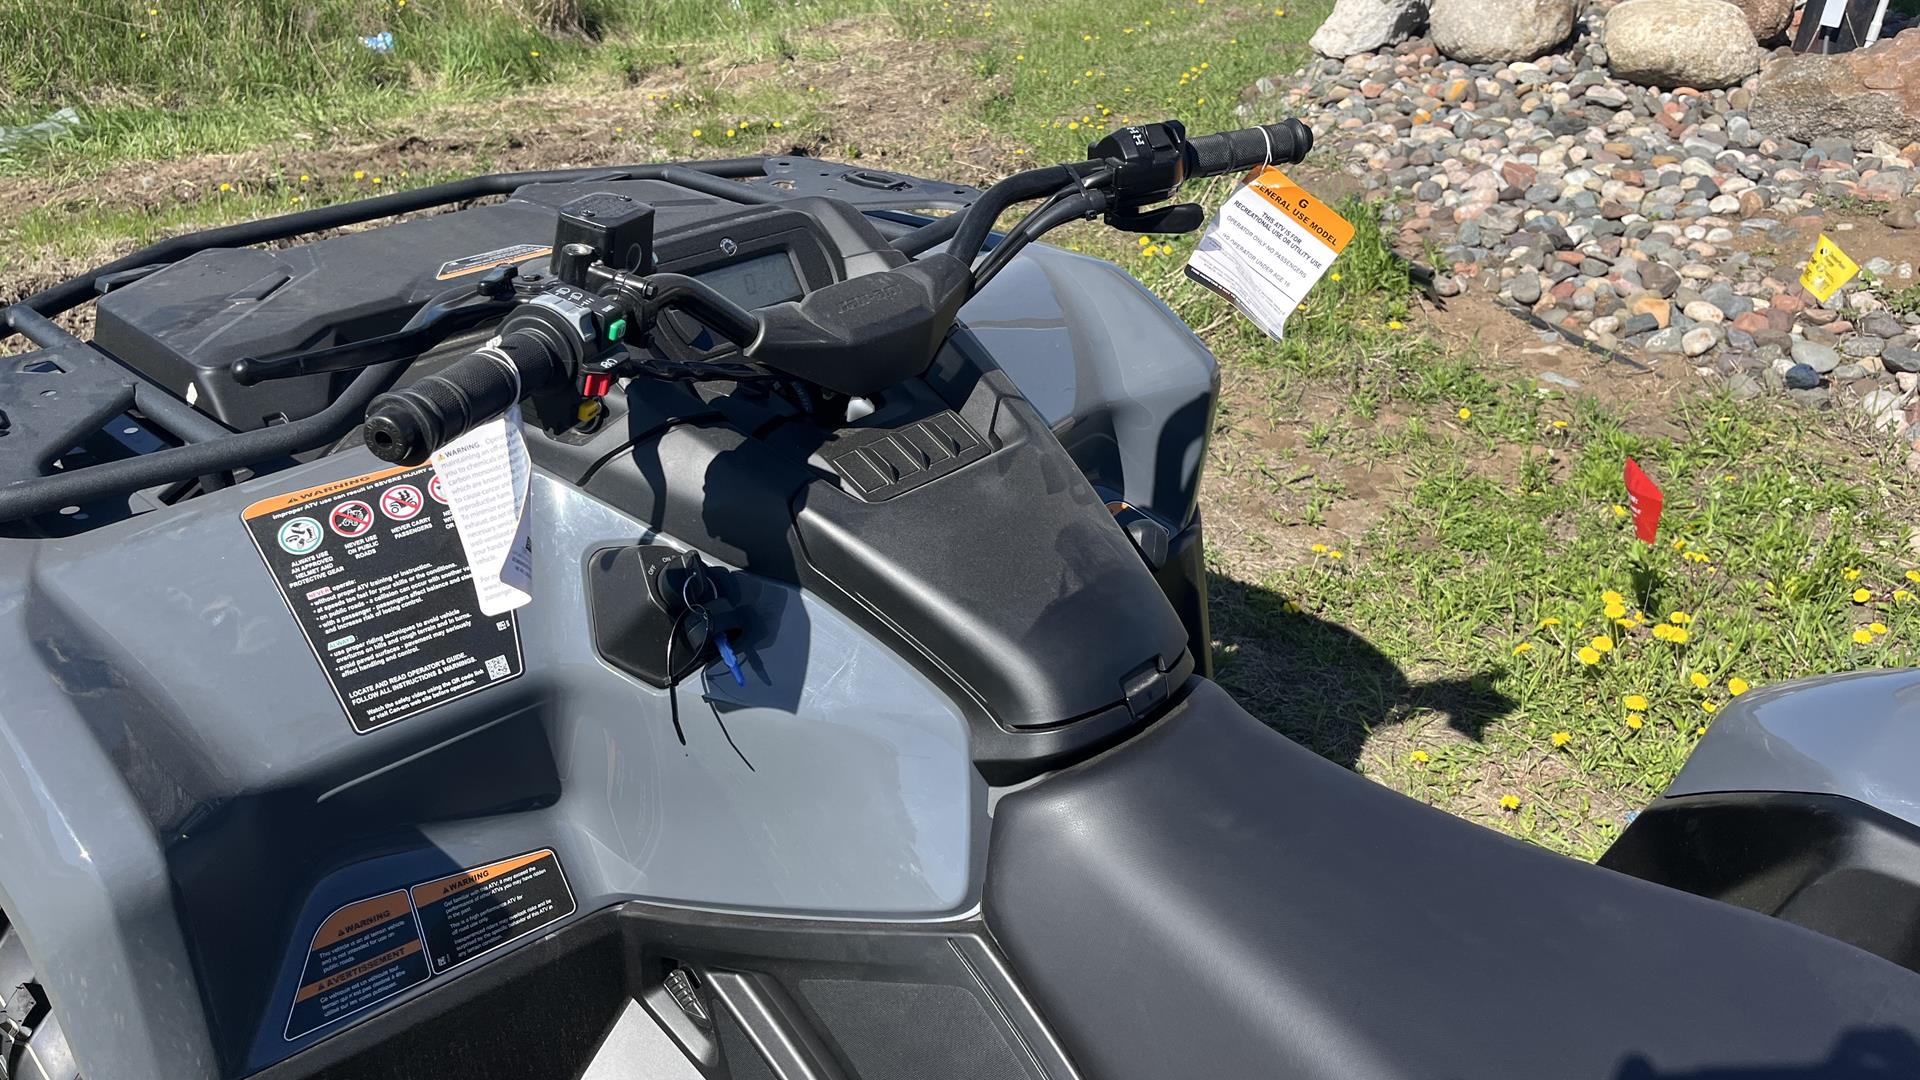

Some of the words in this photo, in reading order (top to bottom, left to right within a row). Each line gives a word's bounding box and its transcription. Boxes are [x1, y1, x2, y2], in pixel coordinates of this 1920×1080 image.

[1299, 199, 1309, 208] G
[1234, 200, 1272, 231] RECREATIONAL
[1272, 229, 1281, 239] USE
[1283, 237, 1291, 245] OR
[1291, 243, 1311, 261] UTILITY
[1310, 256, 1322, 269] USE
[1262, 212, 1274, 224] THIS
[1274, 222, 1286, 232] ATV
[1290, 233, 1302, 244] FOR
[1292, 209, 1310, 224] USE
[1309, 222, 1336, 246] MODEL
[1226, 216, 1253, 239] OPERATOR
[1253, 235, 1274, 254] ONLY-NO
[1274, 250, 1306, 278] PASSENGERS
[1232, 239, 1256, 260] OPERATOR
[1256, 259, 1273, 274] UNDER
[1273, 272, 1283, 282] AGE
[446, 442, 480, 458] WARNING
[273, 507, 303, 519] Improper
[305, 501, 317, 509] ATV
[346, 487, 365, 496] result
[374, 476, 401, 487] SEVERE
[403, 468, 426, 478] INJURY
[300, 477, 369, 498] WARNING
[391, 523, 410, 533] NEVER
[411, 517, 430, 526] CARRY
[395, 523, 432, 539] PASSENGERS
[344, 539, 364, 548] NEVER
[365, 534, 377, 542] USE
[358, 541, 379, 551] PUBLIC
[292, 555, 315, 567] ALWAYS
[301, 556, 333, 570] APPROVED
[355, 549, 376, 559] ROADS
[289, 572, 326, 588] PROTECTIVE
[327, 566, 344, 575] GEAR
[295, 567, 319, 579] HELMET
[321, 563, 333, 571] AND
[308, 588, 329, 597] NEVER
[349, 685, 374, 698] LOCATE
[375, 680, 388, 689] AND
[389, 674, 406, 684] READ
[407, 660, 445, 677] OPERATOR'S
[446, 652, 467, 663] GUIDE.
[352, 692, 378, 705] FOLLOW
[380, 687, 392, 695] ALL
[392, 671, 436, 690] INSTRUCTIONS
[443, 657, 476, 672] WARNINGS.
[449, 870, 489, 892] WARNING
[345, 911, 390, 932] WARNING
[327, 948, 405, 986] AVERTISSEMENT
